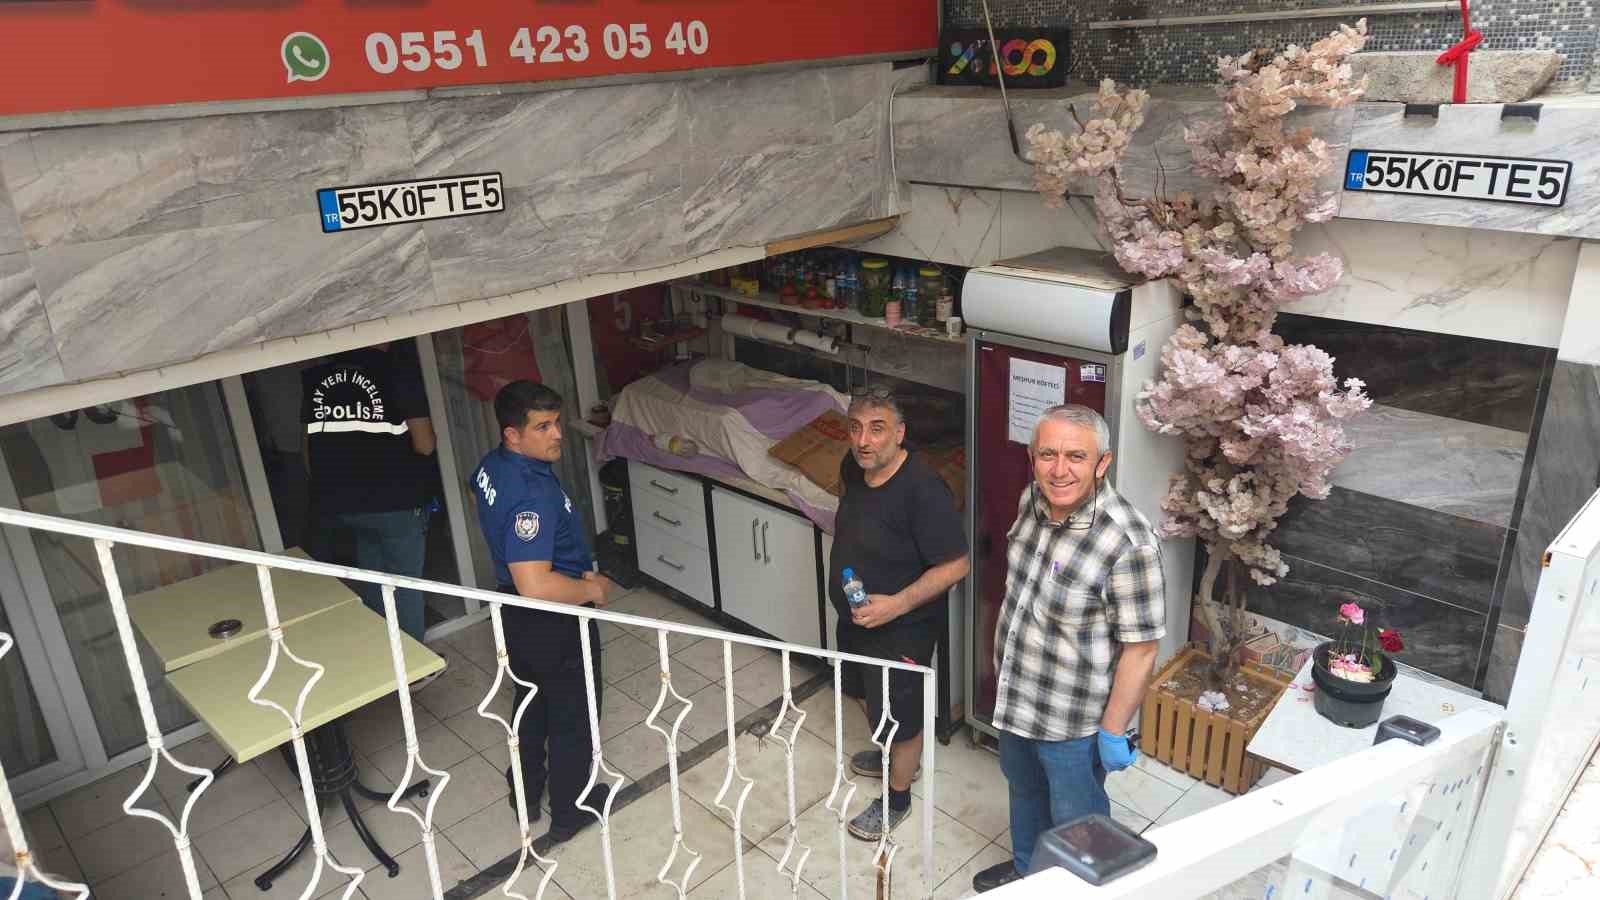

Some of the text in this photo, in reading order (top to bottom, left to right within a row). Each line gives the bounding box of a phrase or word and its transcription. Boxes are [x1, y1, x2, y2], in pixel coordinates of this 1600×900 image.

[364, 20, 709, 74] 0551 423 05 40
[1350, 156, 1565, 200] TR 55KÖFTE5
[325, 178, 500, 224] TR 55KÖFTE5
[313, 389, 325, 419] OLAY
